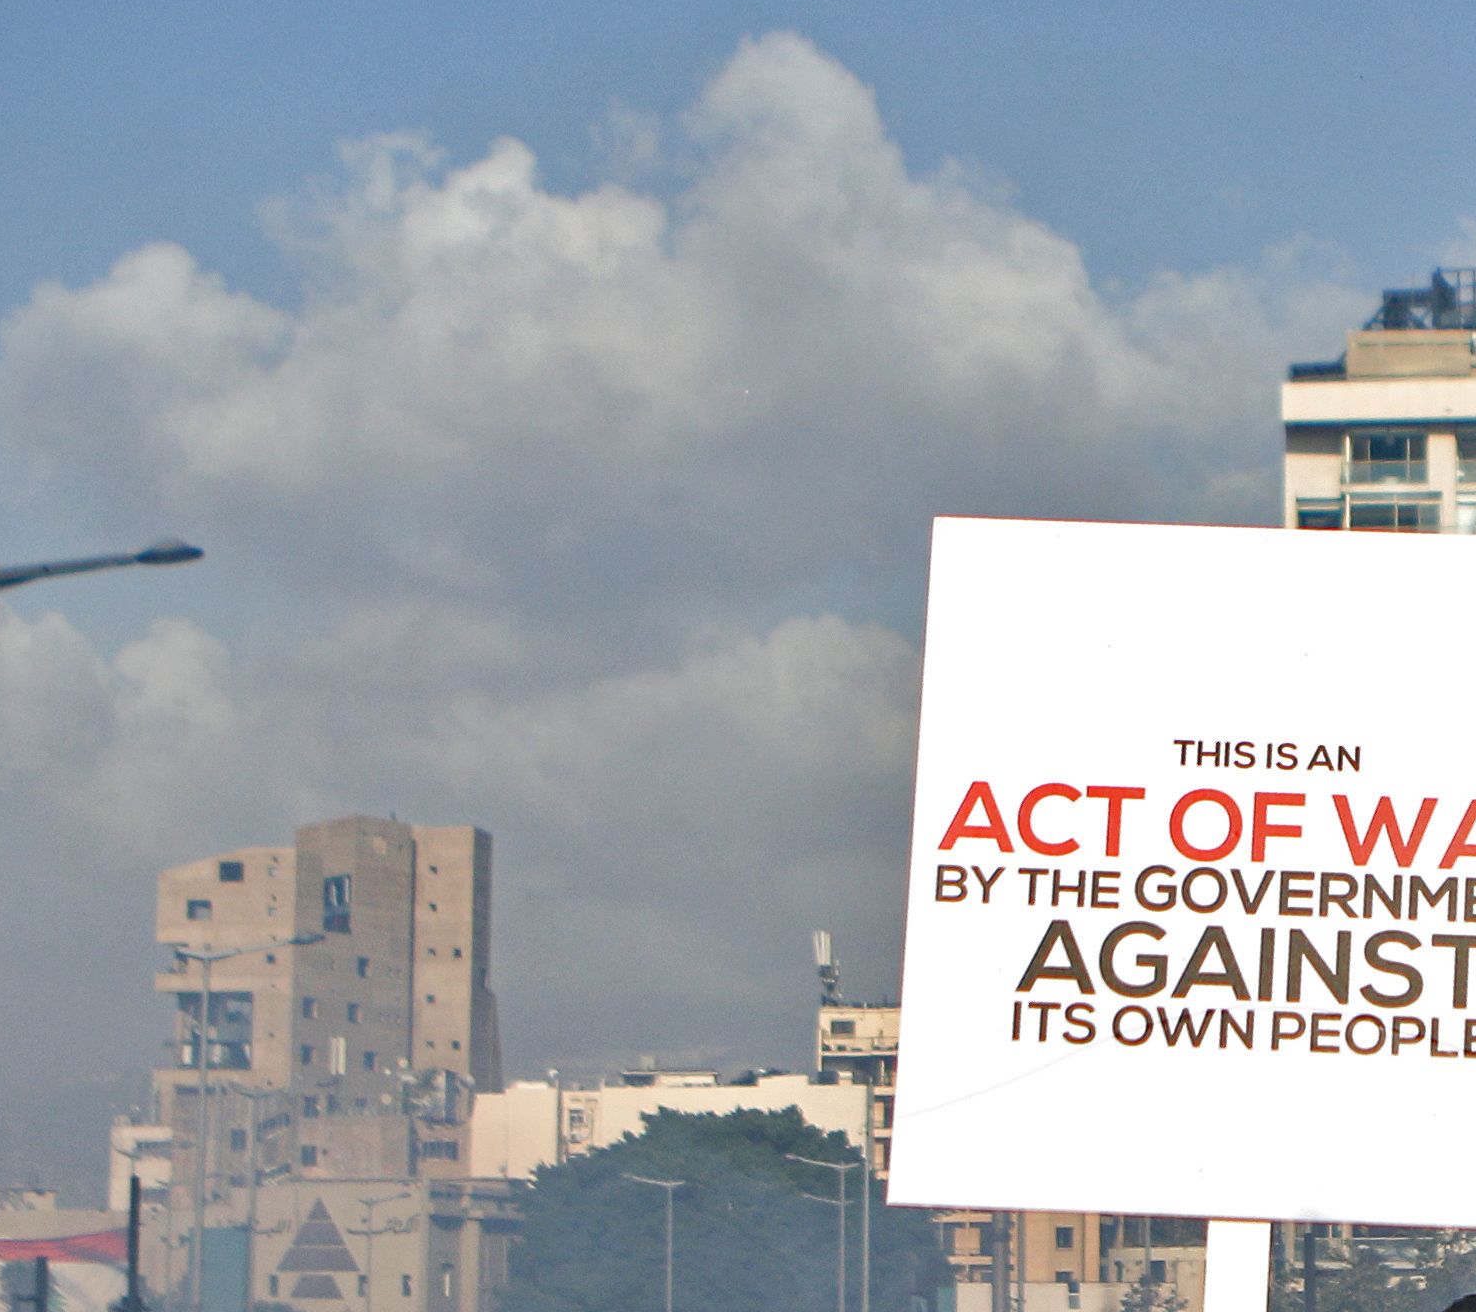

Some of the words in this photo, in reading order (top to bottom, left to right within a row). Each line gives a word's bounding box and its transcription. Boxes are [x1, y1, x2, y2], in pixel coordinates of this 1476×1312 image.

[1174, 740, 1255, 769] THIS
[1266, 743, 1298, 770] IS
[1307, 745, 1360, 771] AN
[938, 781, 1145, 857] ACT
[1169, 789, 1305, 862] OF
[935, 865, 1005, 903] BY
[1018, 868, 1121, 909] THE
[1012, 1001, 1096, 1044] ITS
[1112, 1005, 1254, 1049] OWN
